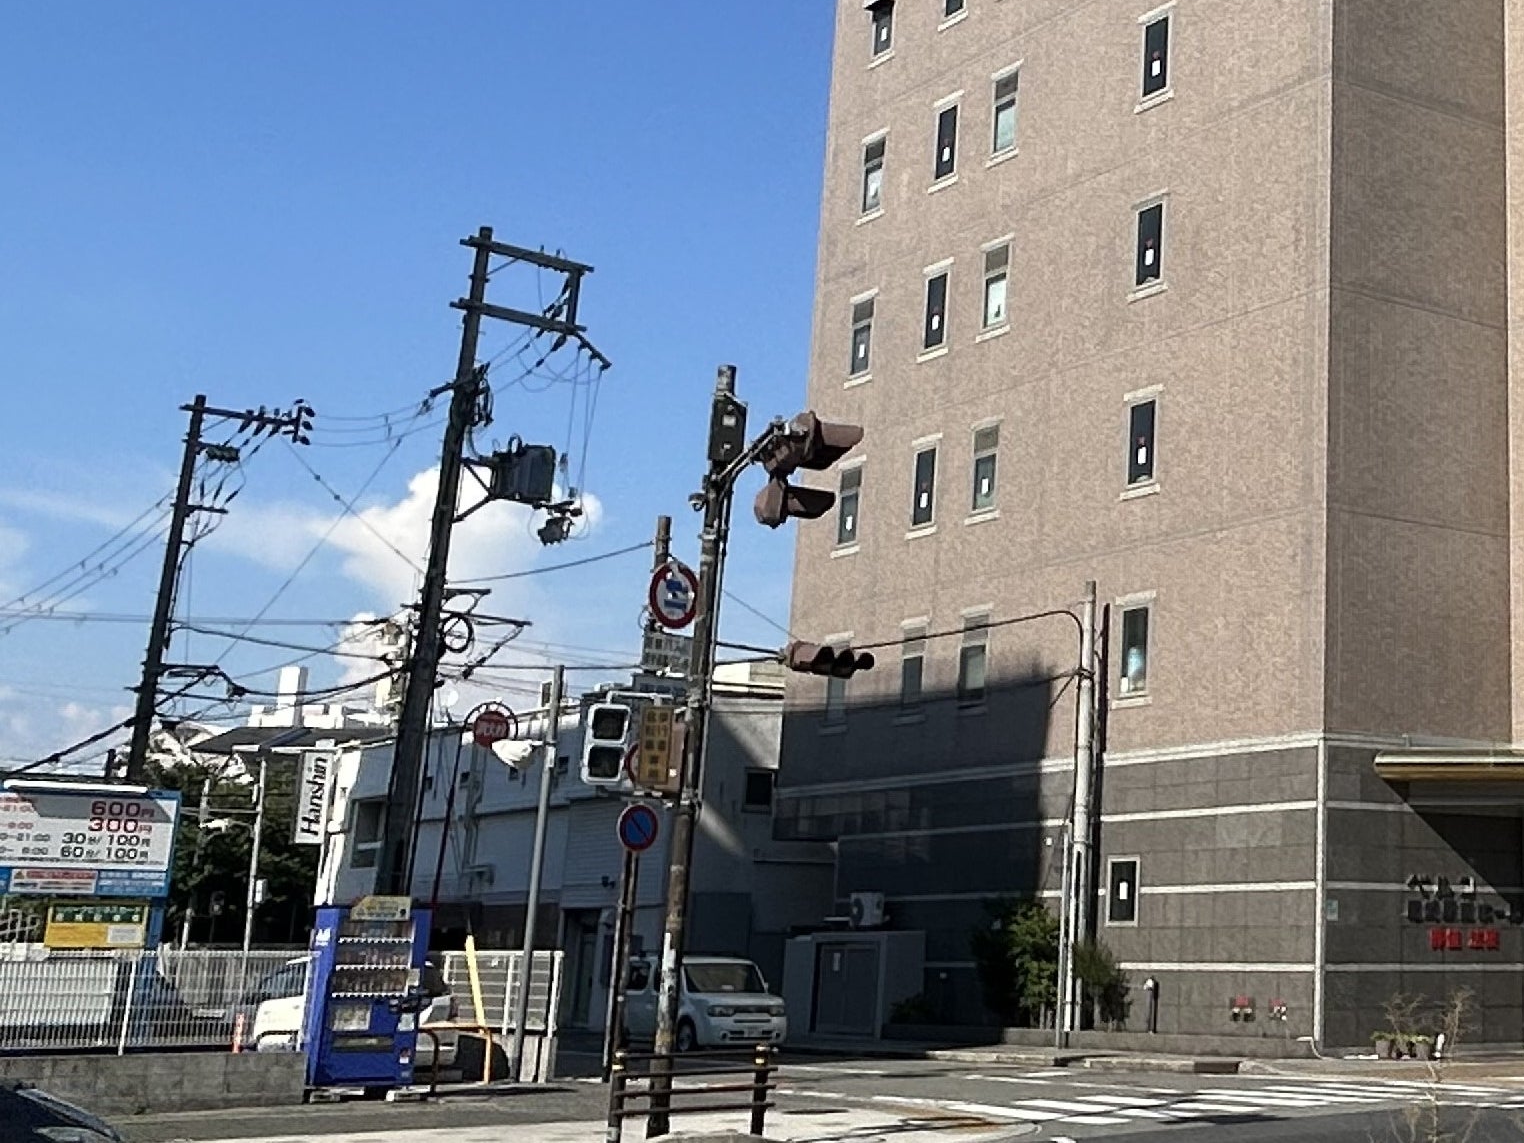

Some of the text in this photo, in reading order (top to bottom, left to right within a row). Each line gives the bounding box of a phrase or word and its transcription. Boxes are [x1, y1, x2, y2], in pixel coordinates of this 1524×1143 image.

[301, 757, 328, 836] Hanshin
[91, 800, 155, 818] 600円
[88, 817, 153, 834] 300円
